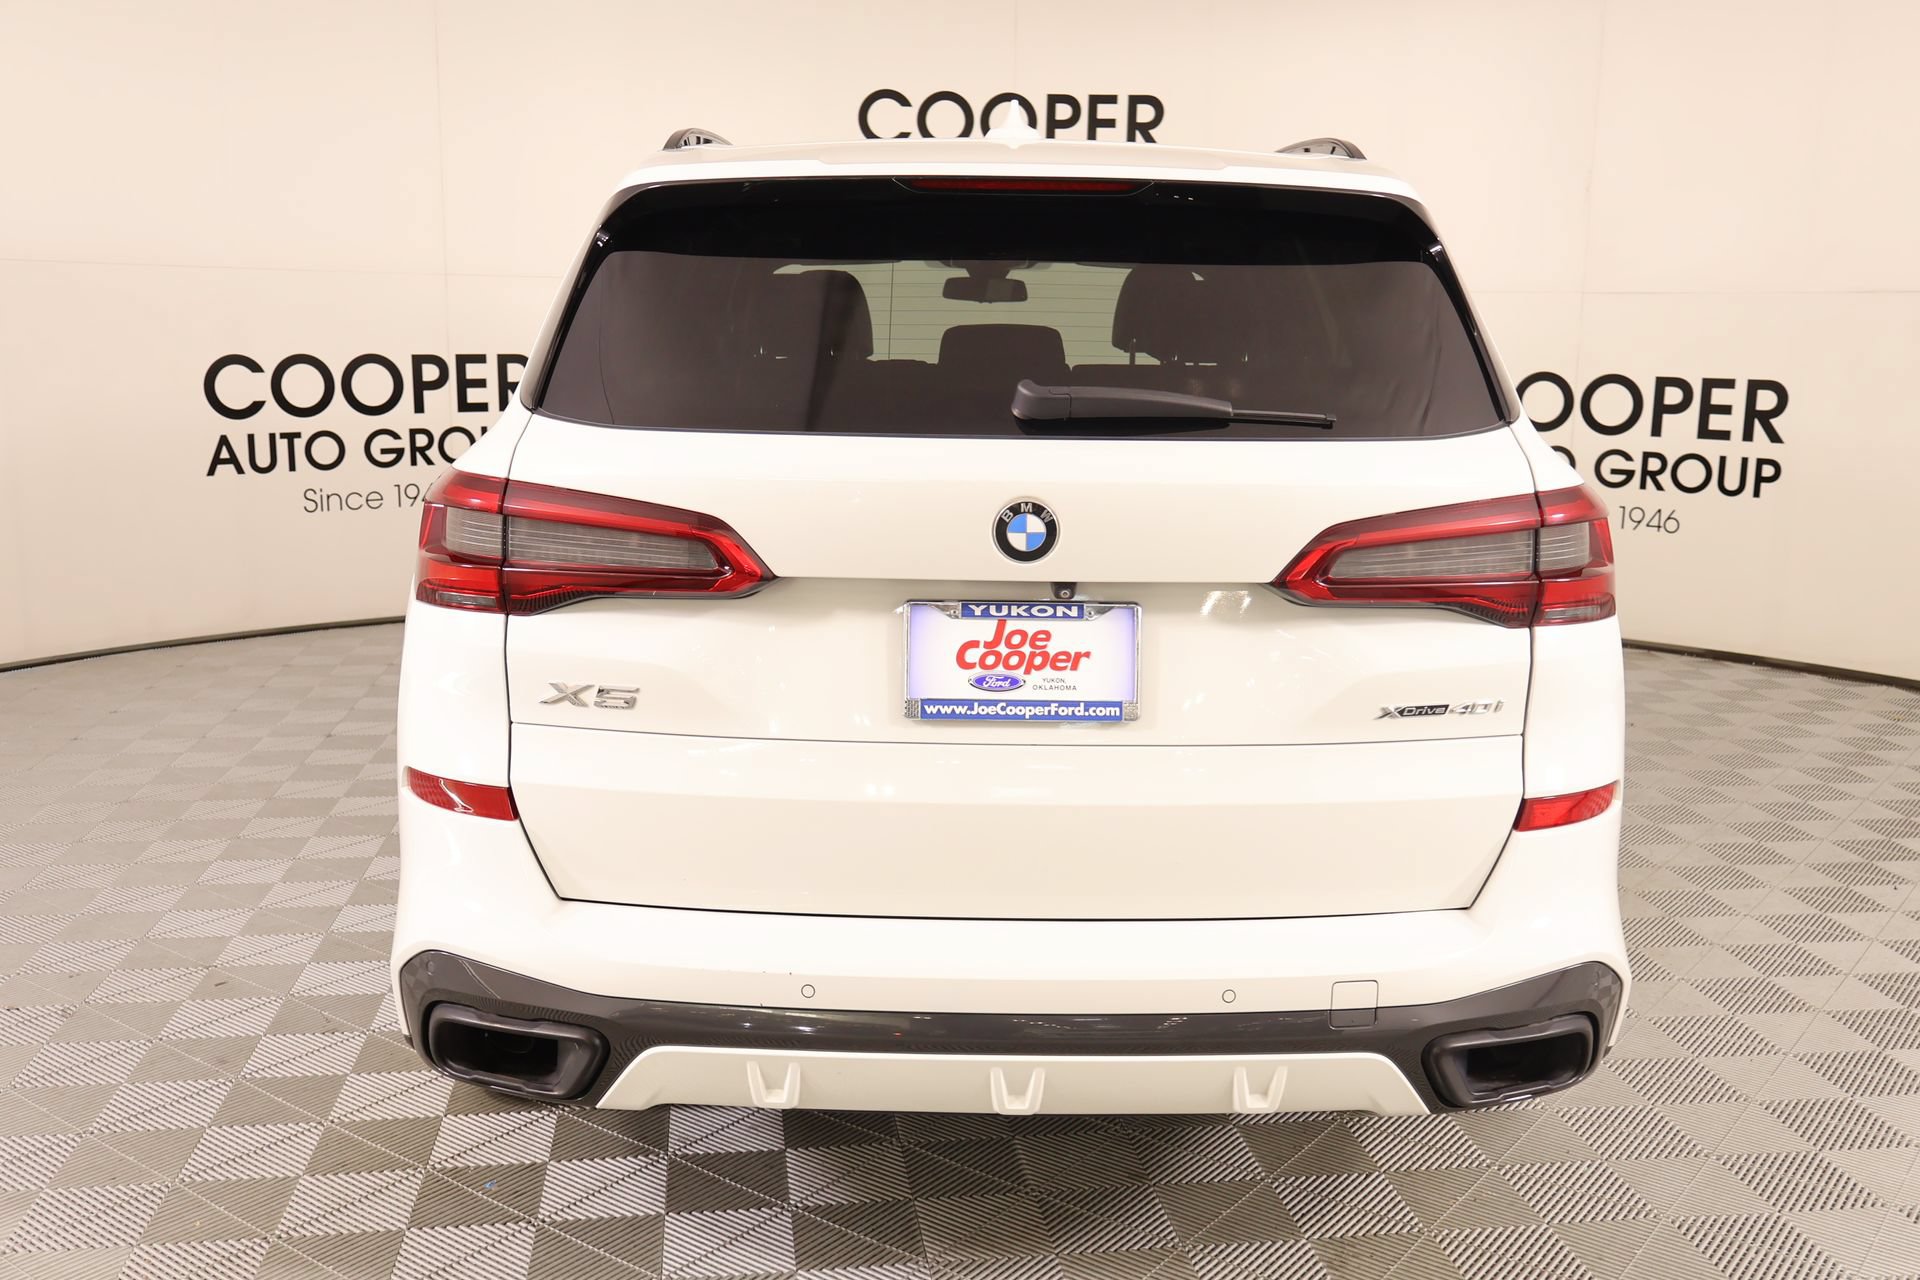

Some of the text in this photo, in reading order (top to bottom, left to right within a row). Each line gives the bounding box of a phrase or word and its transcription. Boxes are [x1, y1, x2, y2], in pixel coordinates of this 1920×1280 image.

[858, 89, 1164, 143] COOPER
[1515, 371, 1789, 444] OOPER
[206, 425, 487, 477] AUTO GRO
[1594, 448, 1782, 498] GROUP
[303, 488, 384, 513] Since
[1001, 502, 1054, 523] BMW
[1619, 505, 1680, 534] 1946
[968, 604, 1078, 617] YUKON
[983, 619, 1051, 650] Joe
[955, 640, 1091, 675] Cooper
[539, 682, 640, 709] X5
[982, 675, 1011, 689] Ford
[924, 702, 1120, 718] www.JoeCooperFord.com
